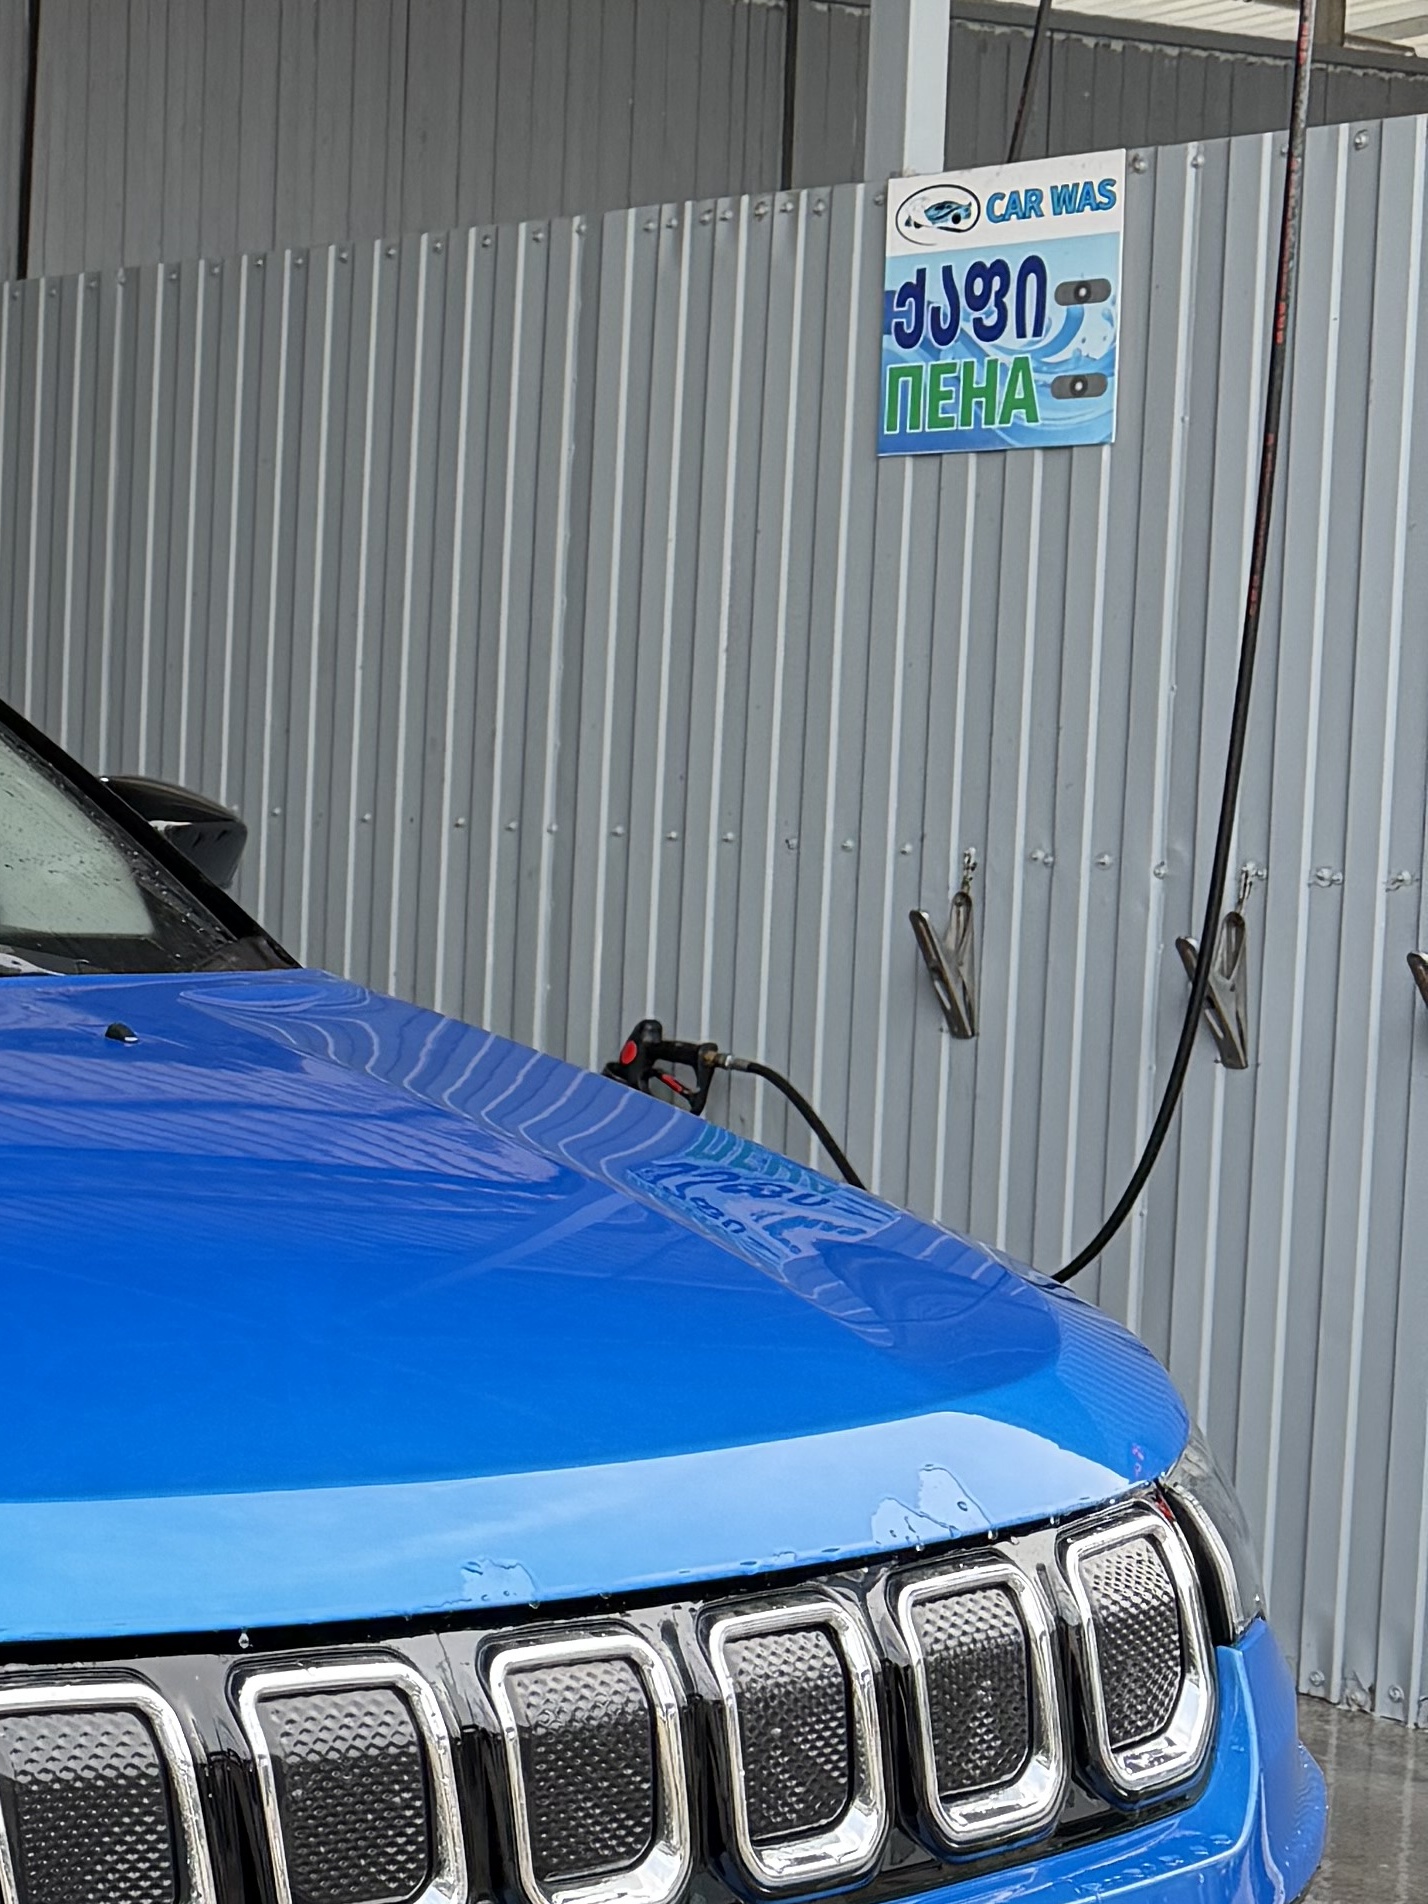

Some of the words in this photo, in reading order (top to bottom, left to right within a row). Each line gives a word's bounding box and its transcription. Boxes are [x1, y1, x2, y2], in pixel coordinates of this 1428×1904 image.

[986, 188, 1044, 224] CAR
[1050, 178, 1117, 216] WAS
[892, 255, 1047, 349] ქაფი
[884, 355, 1040, 434] ПЕНА
